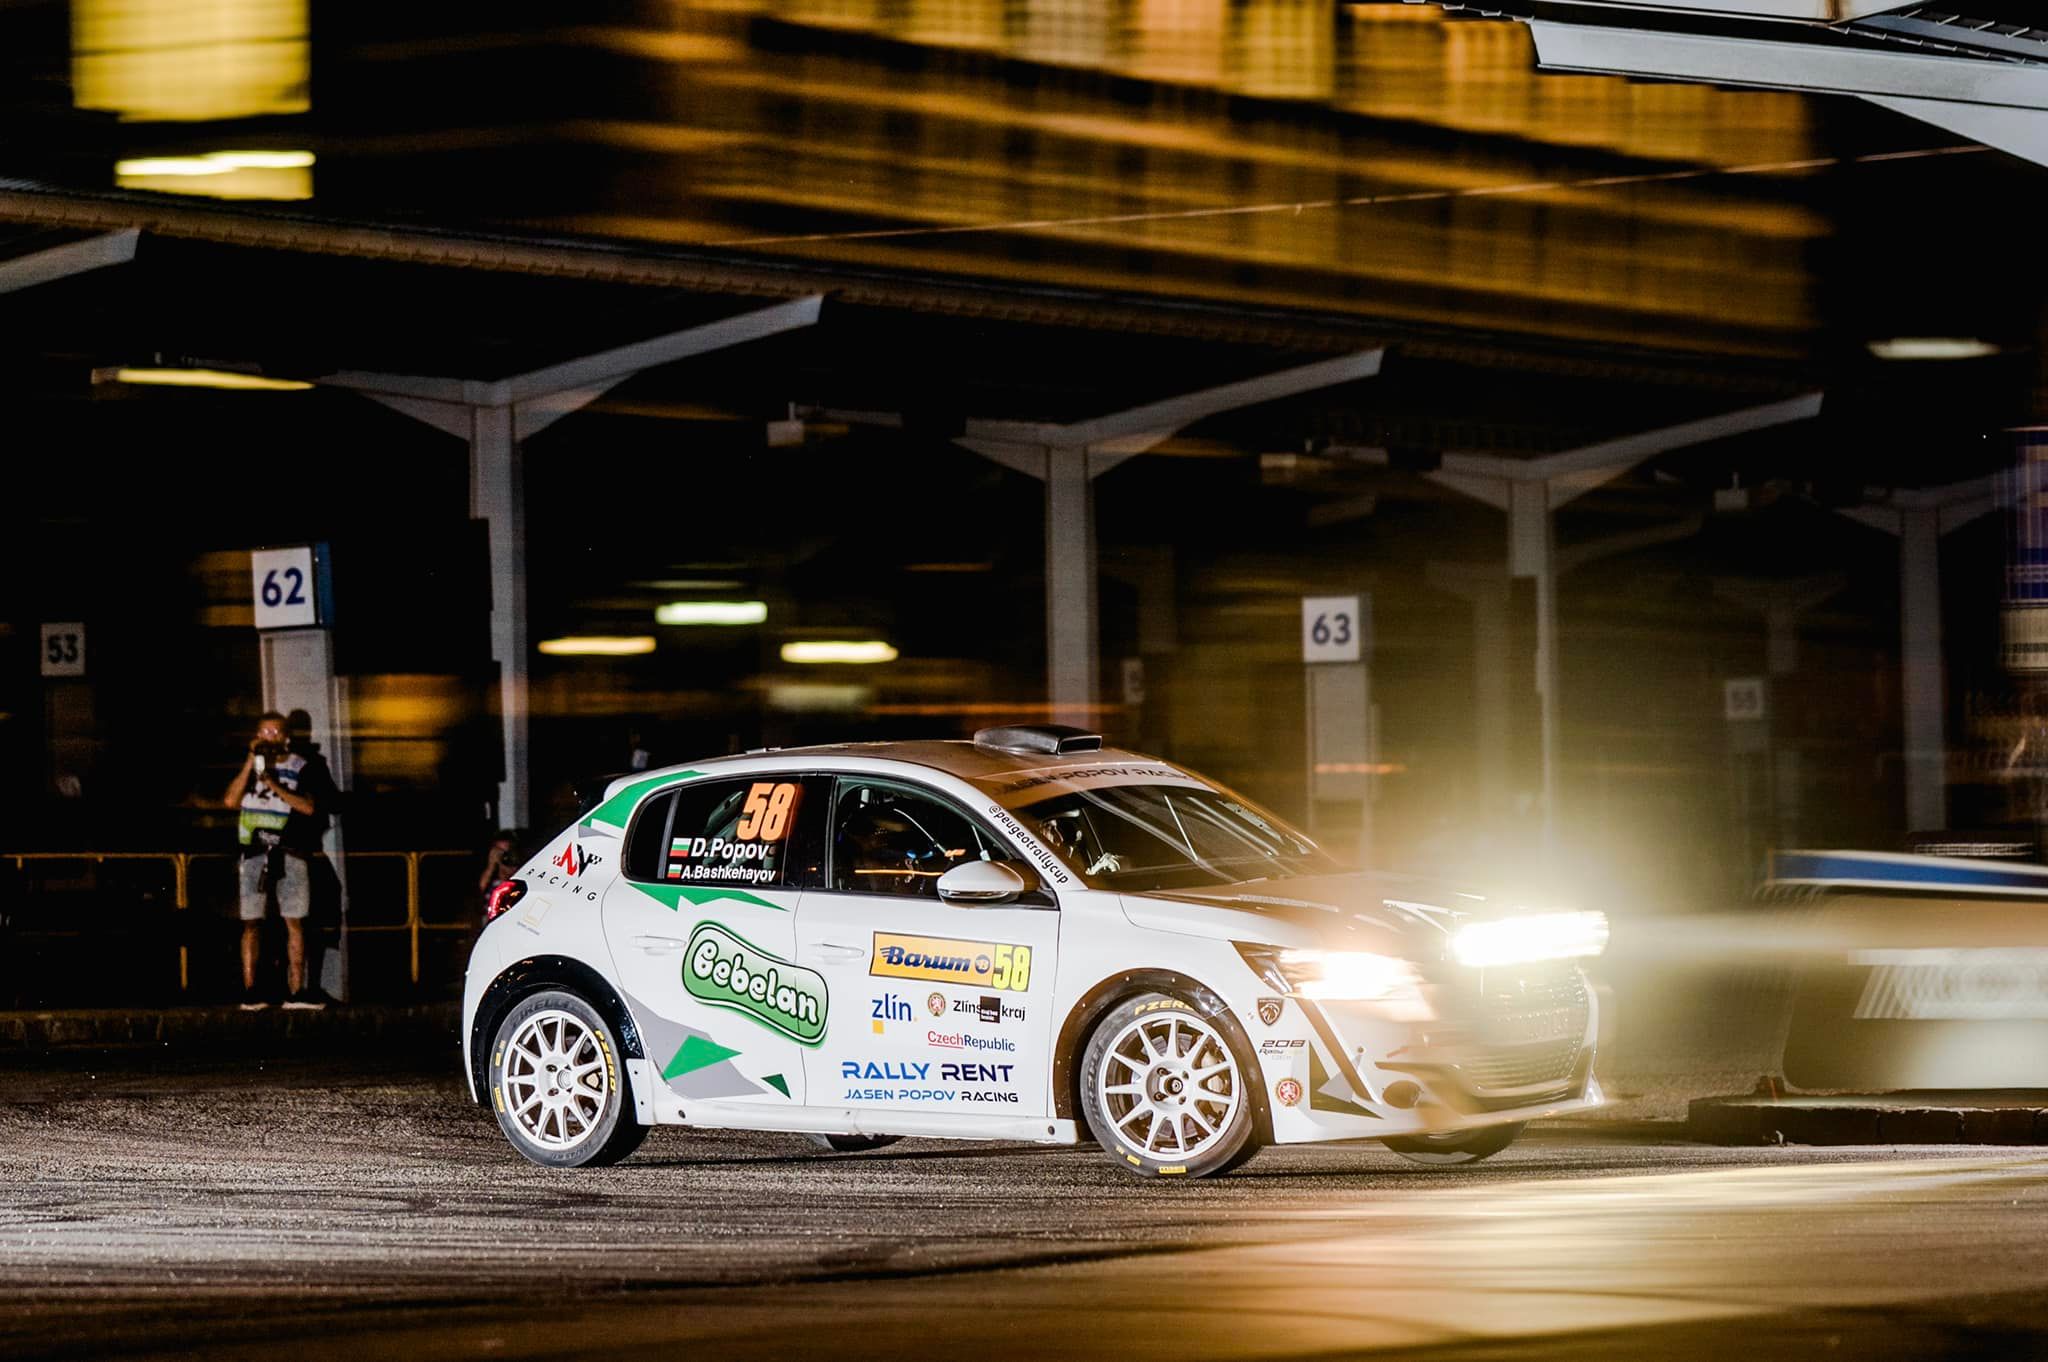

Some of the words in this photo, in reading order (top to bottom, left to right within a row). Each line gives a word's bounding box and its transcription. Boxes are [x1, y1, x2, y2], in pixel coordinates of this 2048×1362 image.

[262, 567, 306, 607] 62
[1311, 612, 1352, 647] 63
[48, 633, 78, 664] 53
[737, 782, 796, 841] 58
[690, 837, 770, 864] D.Popov
[988, 804, 1070, 884] @peugeotrallycup
[526, 868, 598, 901] RACING
[681, 864, 777, 884] A.Bashkehayov
[881, 945, 971, 973] Barum
[992, 943, 1031, 992] 58
[691, 938, 820, 1026] Bebelan
[871, 993, 912, 1022] zlín
[1001, 1004, 1026, 1022] kraj
[1261, 1039, 1307, 1049] 208
[841, 1061, 931, 1081] RALLY
[941, 1063, 1014, 1082] RENT
[844, 1088, 894, 1101] JASEN
[898, 1089, 956, 1102] POPOV
[961, 1090, 1019, 1104] RACING
